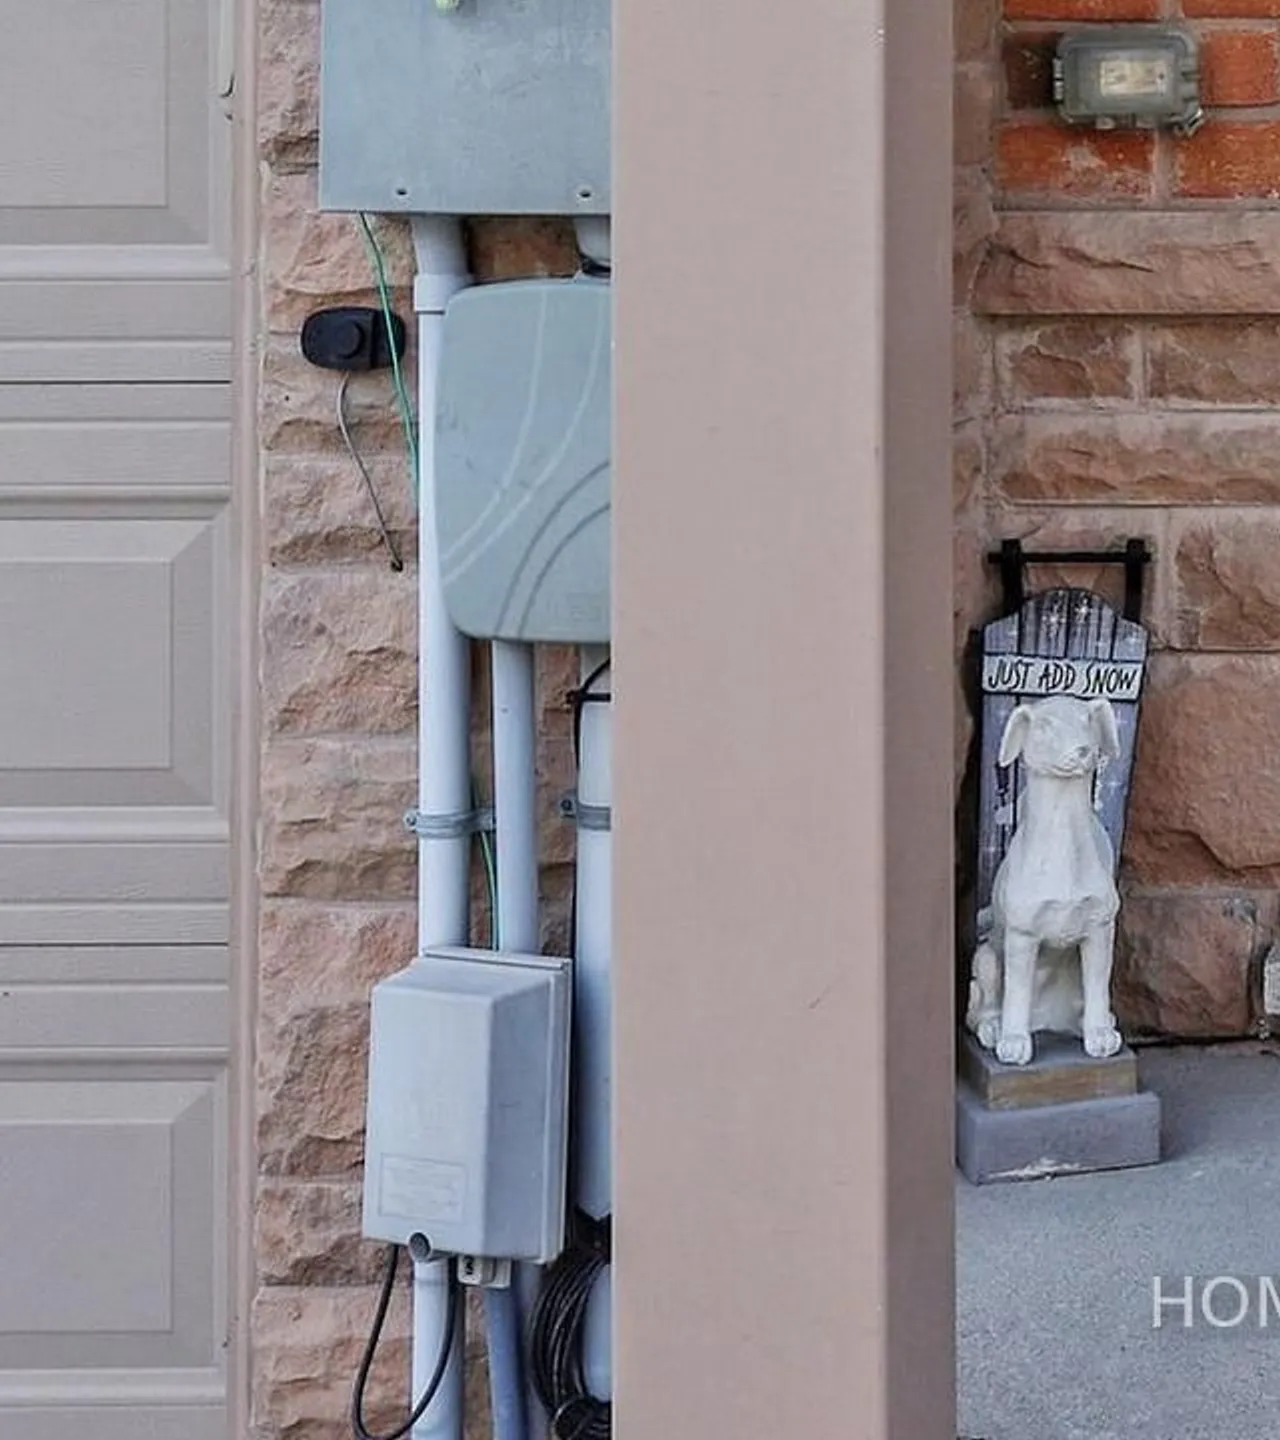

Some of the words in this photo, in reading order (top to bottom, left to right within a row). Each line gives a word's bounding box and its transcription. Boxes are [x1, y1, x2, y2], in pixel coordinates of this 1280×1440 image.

[988, 659, 1034, 689] JUST
[1038, 662, 1077, 691] ADD
[1081, 662, 1137, 695] SNOW
